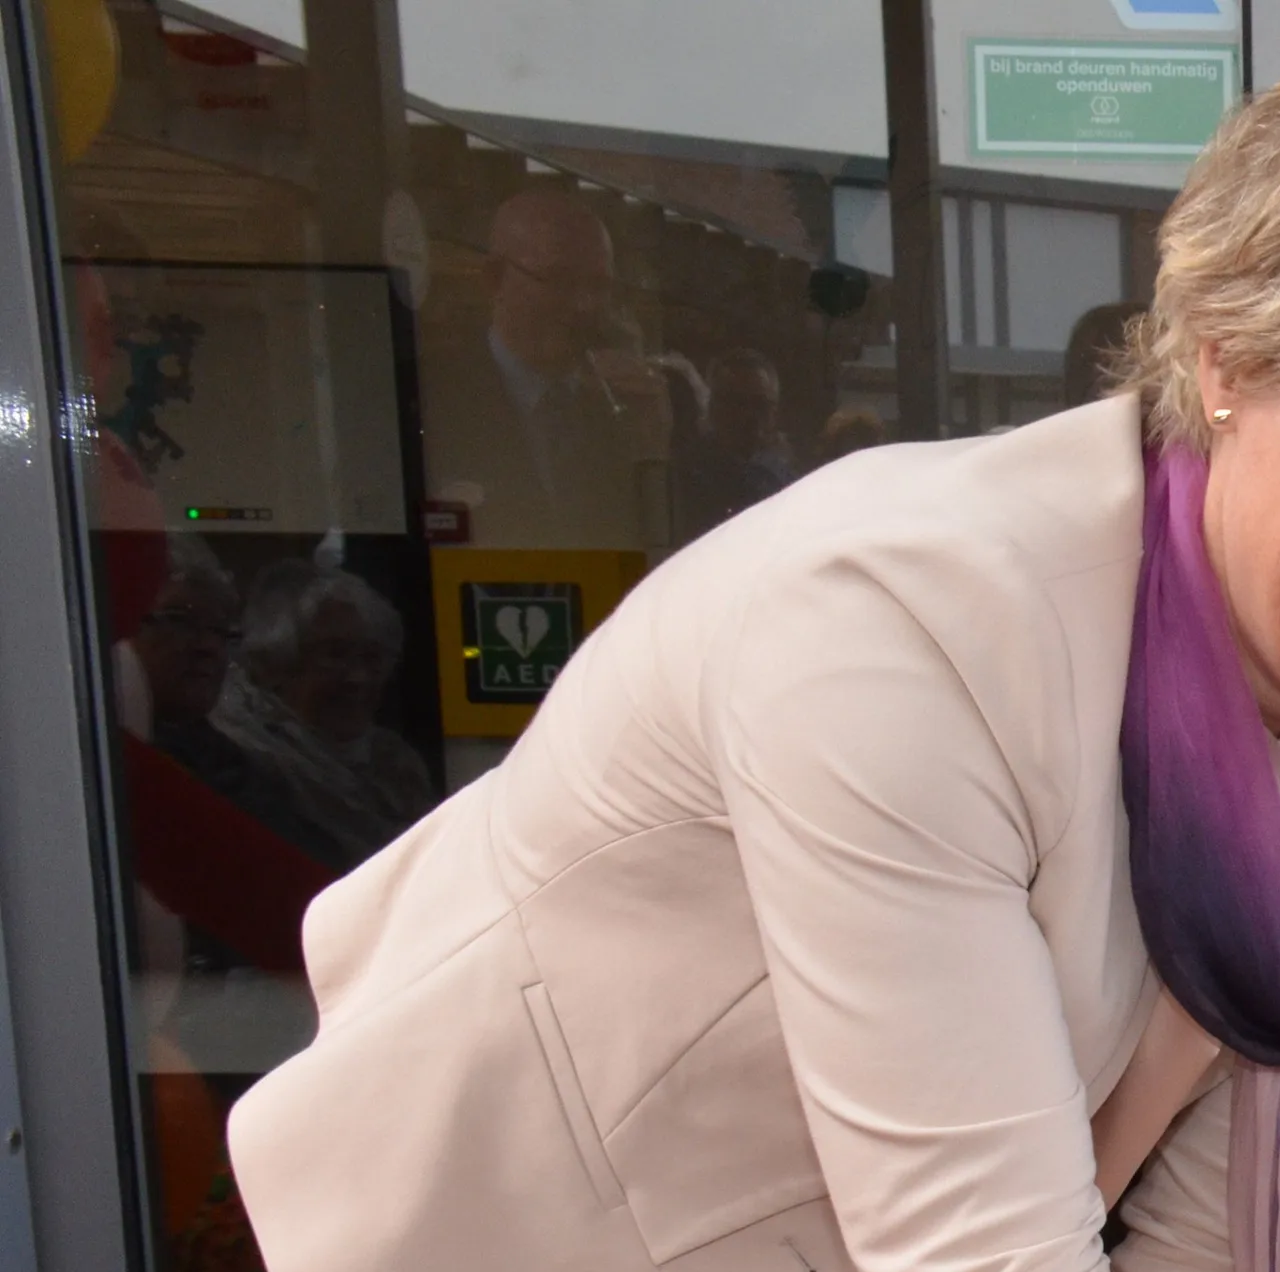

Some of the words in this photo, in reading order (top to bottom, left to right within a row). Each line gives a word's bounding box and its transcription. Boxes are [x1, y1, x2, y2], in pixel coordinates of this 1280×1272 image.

[990, 59, 1010, 77] bij
[1016, 60, 1063, 75] brand
[1068, 61, 1125, 76] deuren
[1131, 62, 1217, 80] handmatig
[1056, 79, 1152, 95] openduwen
[494, 664, 559, 684] AED
